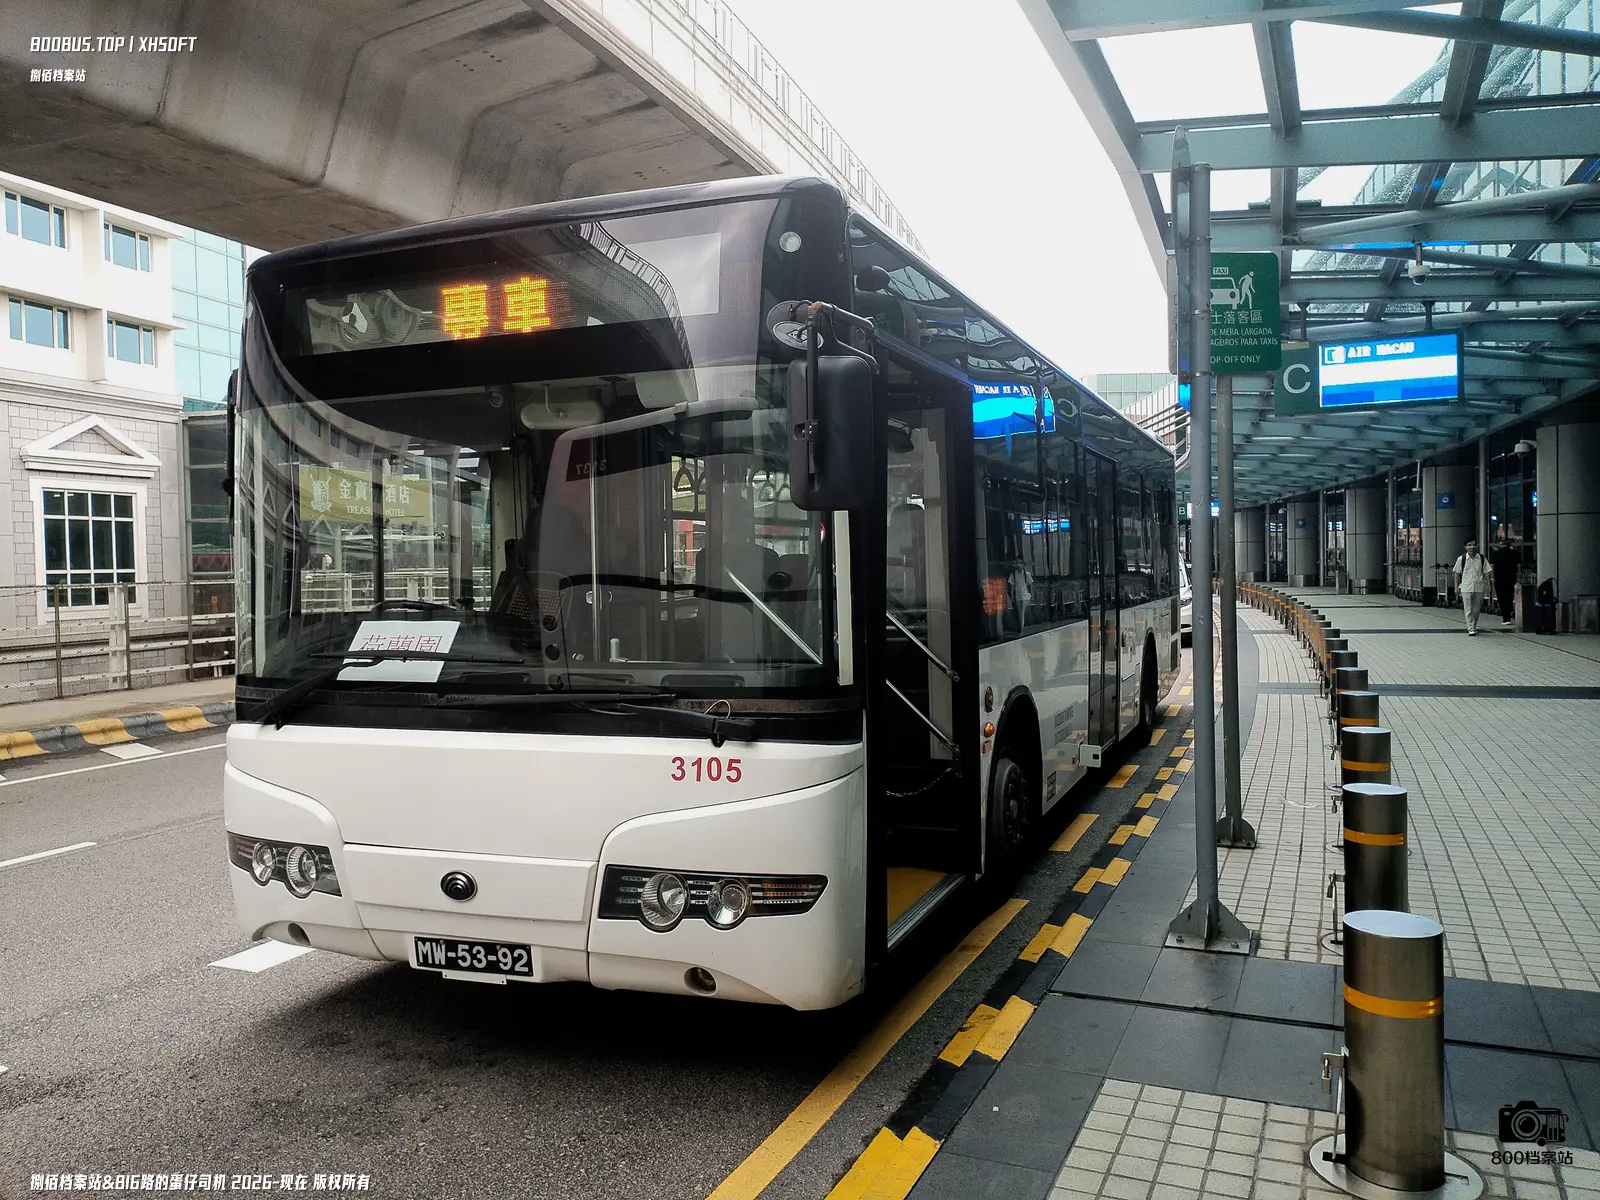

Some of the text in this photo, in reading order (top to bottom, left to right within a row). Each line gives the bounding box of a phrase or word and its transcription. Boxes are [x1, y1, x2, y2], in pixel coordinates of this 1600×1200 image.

[442, 276, 551, 340] 專車
[1211, 310, 1263, 324] 士落客區
[1219, 328, 1239, 336] MERA
[1241, 327, 1273, 336] LARGADA
[1210, 338, 1239, 346] AGEIROS
[1240, 338, 1258, 346] PARA
[1347, 345, 1372, 358] AIR
[1210, 354, 1261, 364] OP-OFF ONLY
[1282, 363, 1311, 394] C
[339, 478, 410, 505] 金寶酒店
[346, 505, 405, 517] TREAS HOTEL
[1179, 506, 1186, 515] B
[671, 756, 742, 783] 3105
[417, 940, 529, 973] MW-53-92
